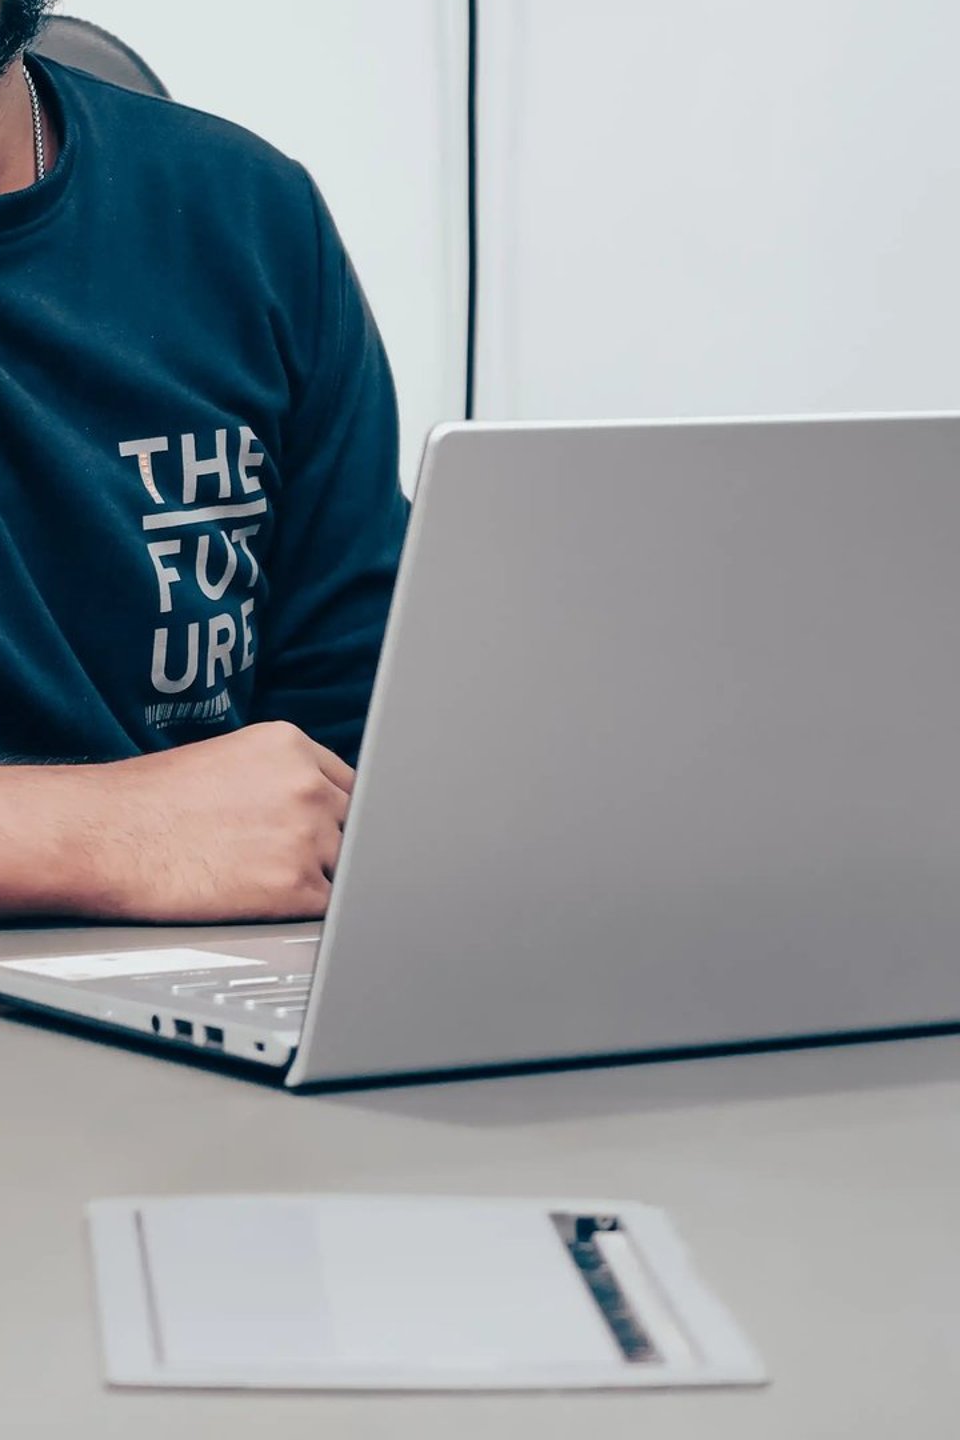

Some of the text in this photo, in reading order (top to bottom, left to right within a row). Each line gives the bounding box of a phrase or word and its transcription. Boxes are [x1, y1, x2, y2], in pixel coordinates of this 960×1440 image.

[119, 426, 265, 504] THE
[147, 524, 261, 612] FUT
[151, 598, 255, 694] URE
